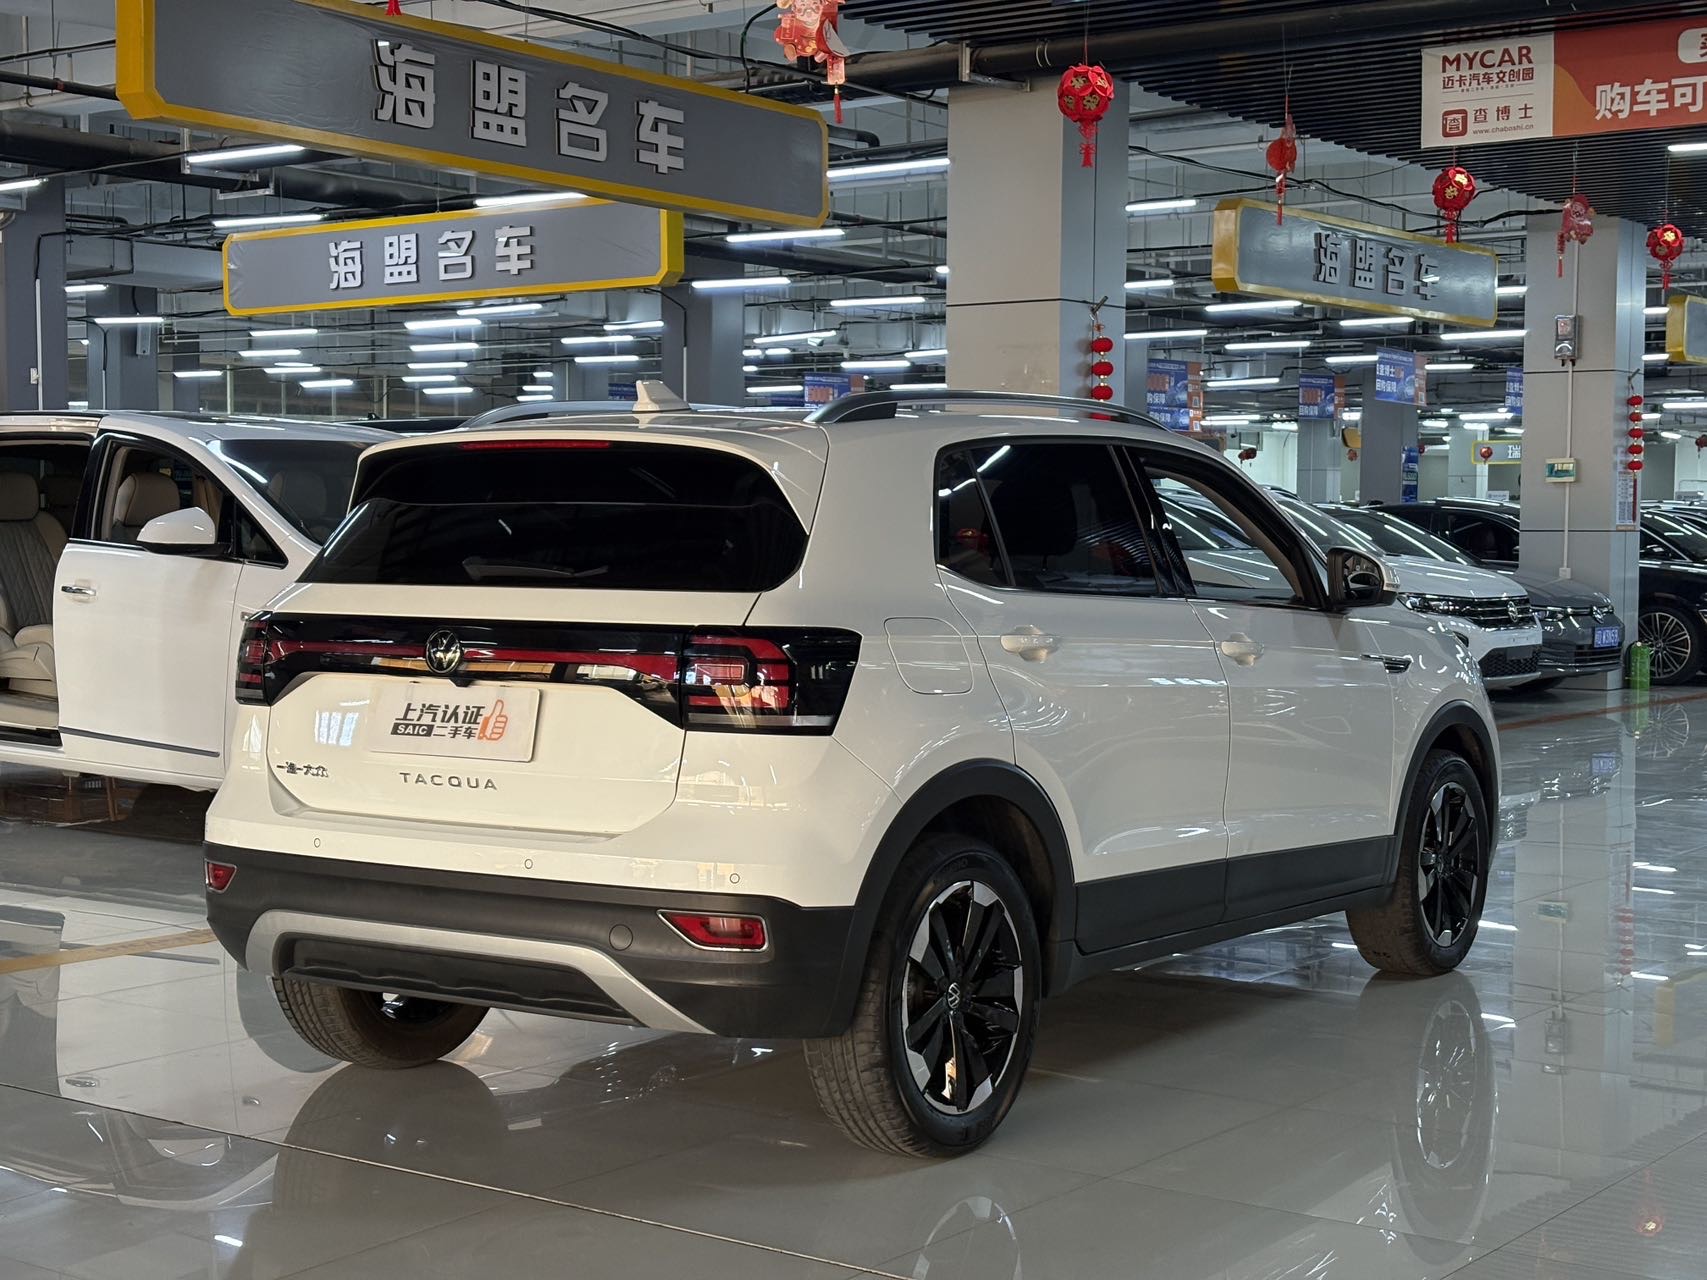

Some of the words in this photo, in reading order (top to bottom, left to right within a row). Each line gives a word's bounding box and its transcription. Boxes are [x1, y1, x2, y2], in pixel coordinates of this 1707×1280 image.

[1441, 46, 1533, 73] MYCAR
[1442, 67, 1534, 90] 迈卡汽车文创园
[370, 38, 685, 175] 海盟名车
[1595, 75, 1707, 120] 购车可
[1473, 103, 1533, 124] 查博士
[1472, 123, 1534, 135] www.chaboshi.cn
[328, 224, 535, 290] 海盟名车
[1313, 232, 1439, 301] 海盟名车
[395, 702, 486, 725] 上汽认证
[396, 723, 428, 736] SAIC
[432, 725, 478, 740] 二手车
[399, 772, 498, 791] TACQUA
